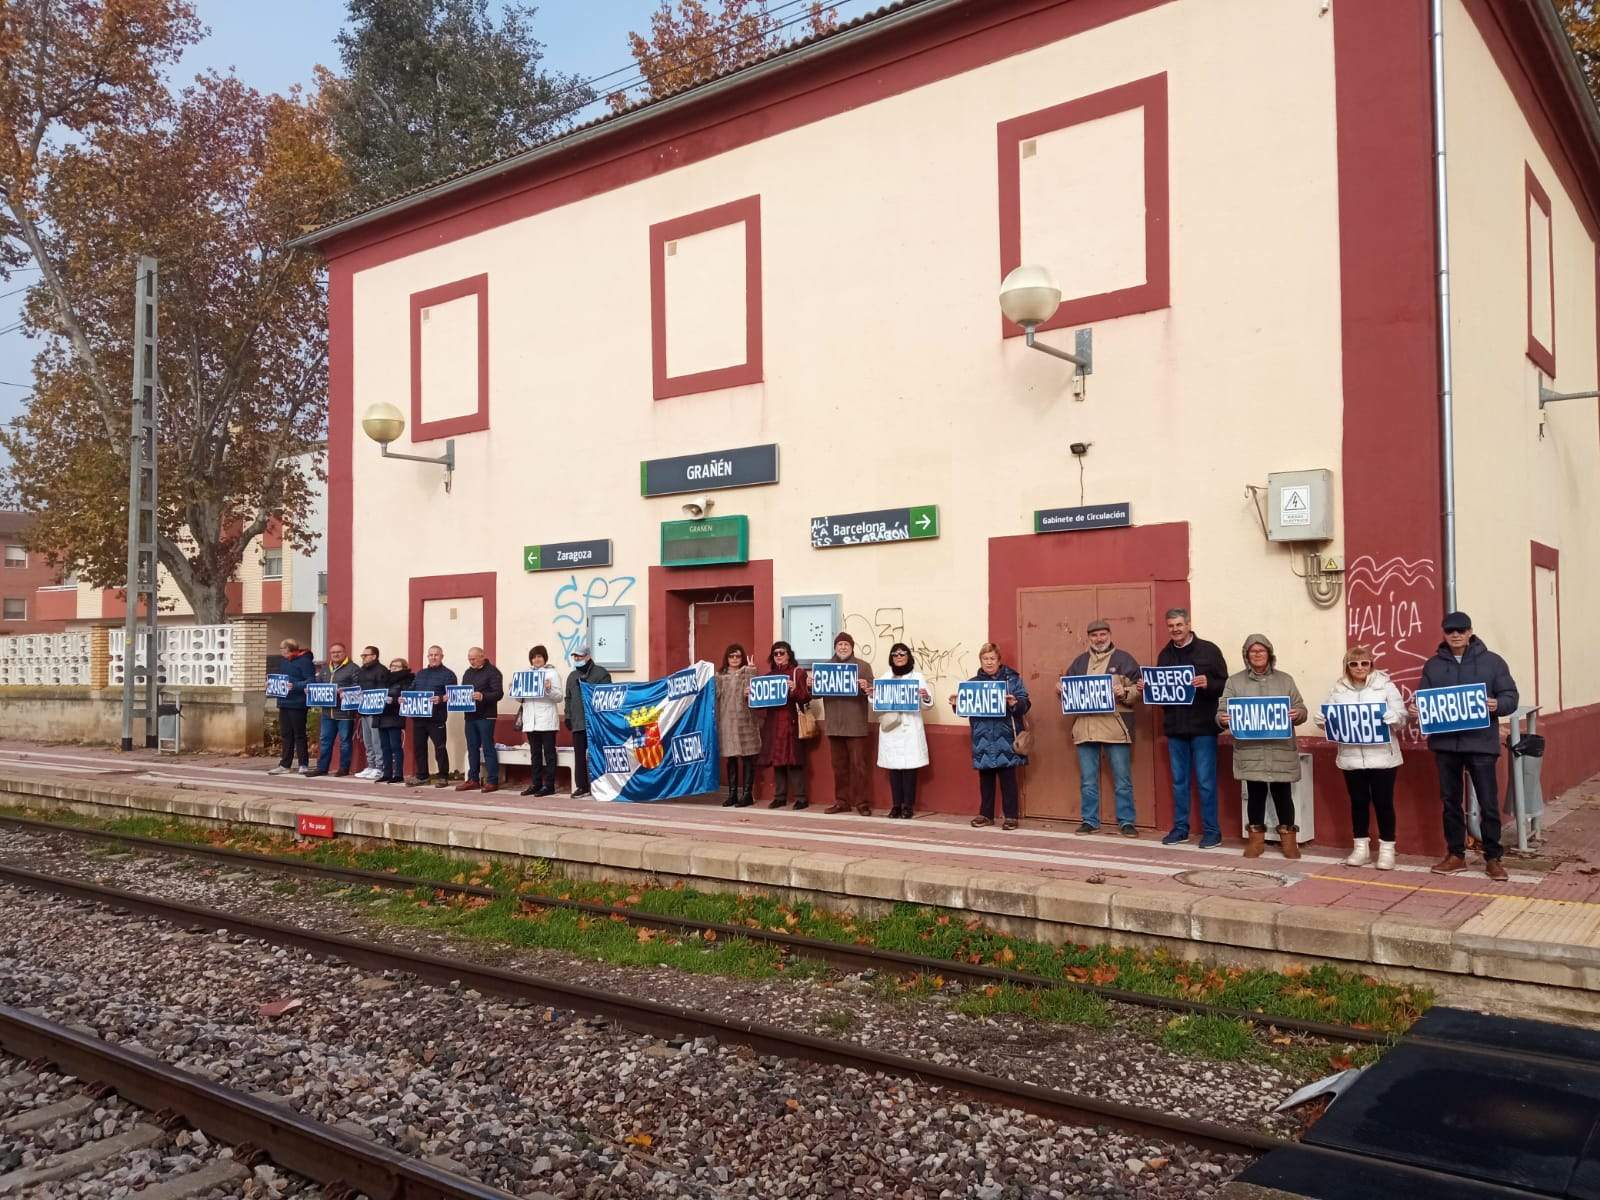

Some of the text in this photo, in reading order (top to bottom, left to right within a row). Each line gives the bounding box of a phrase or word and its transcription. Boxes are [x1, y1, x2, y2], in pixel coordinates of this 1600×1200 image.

[686, 458, 732, 480] GRAÑÉN
[1042, 510, 1126, 525] Gabinete de Circulación
[833, 521, 886, 537] Barcelona
[557, 550, 592, 562] Zaragoza
[814, 665, 857, 693] GRAÑÉN
[1143, 669, 1193, 687] ALBERO
[309, 687, 334, 703] TORRES
[750, 679, 788, 701] SODETO
[874, 683, 918, 705] ALMUNIENTE
[957, 683, 1006, 715] GRAÑÉN
[1062, 678, 1114, 711] SANGARREN
[1151, 685, 1186, 702] BAJO
[1229, 703, 1290, 732] TRAMACED
[1418, 690, 1487, 725] BARBUES
[1326, 703, 1384, 743] CURBE
